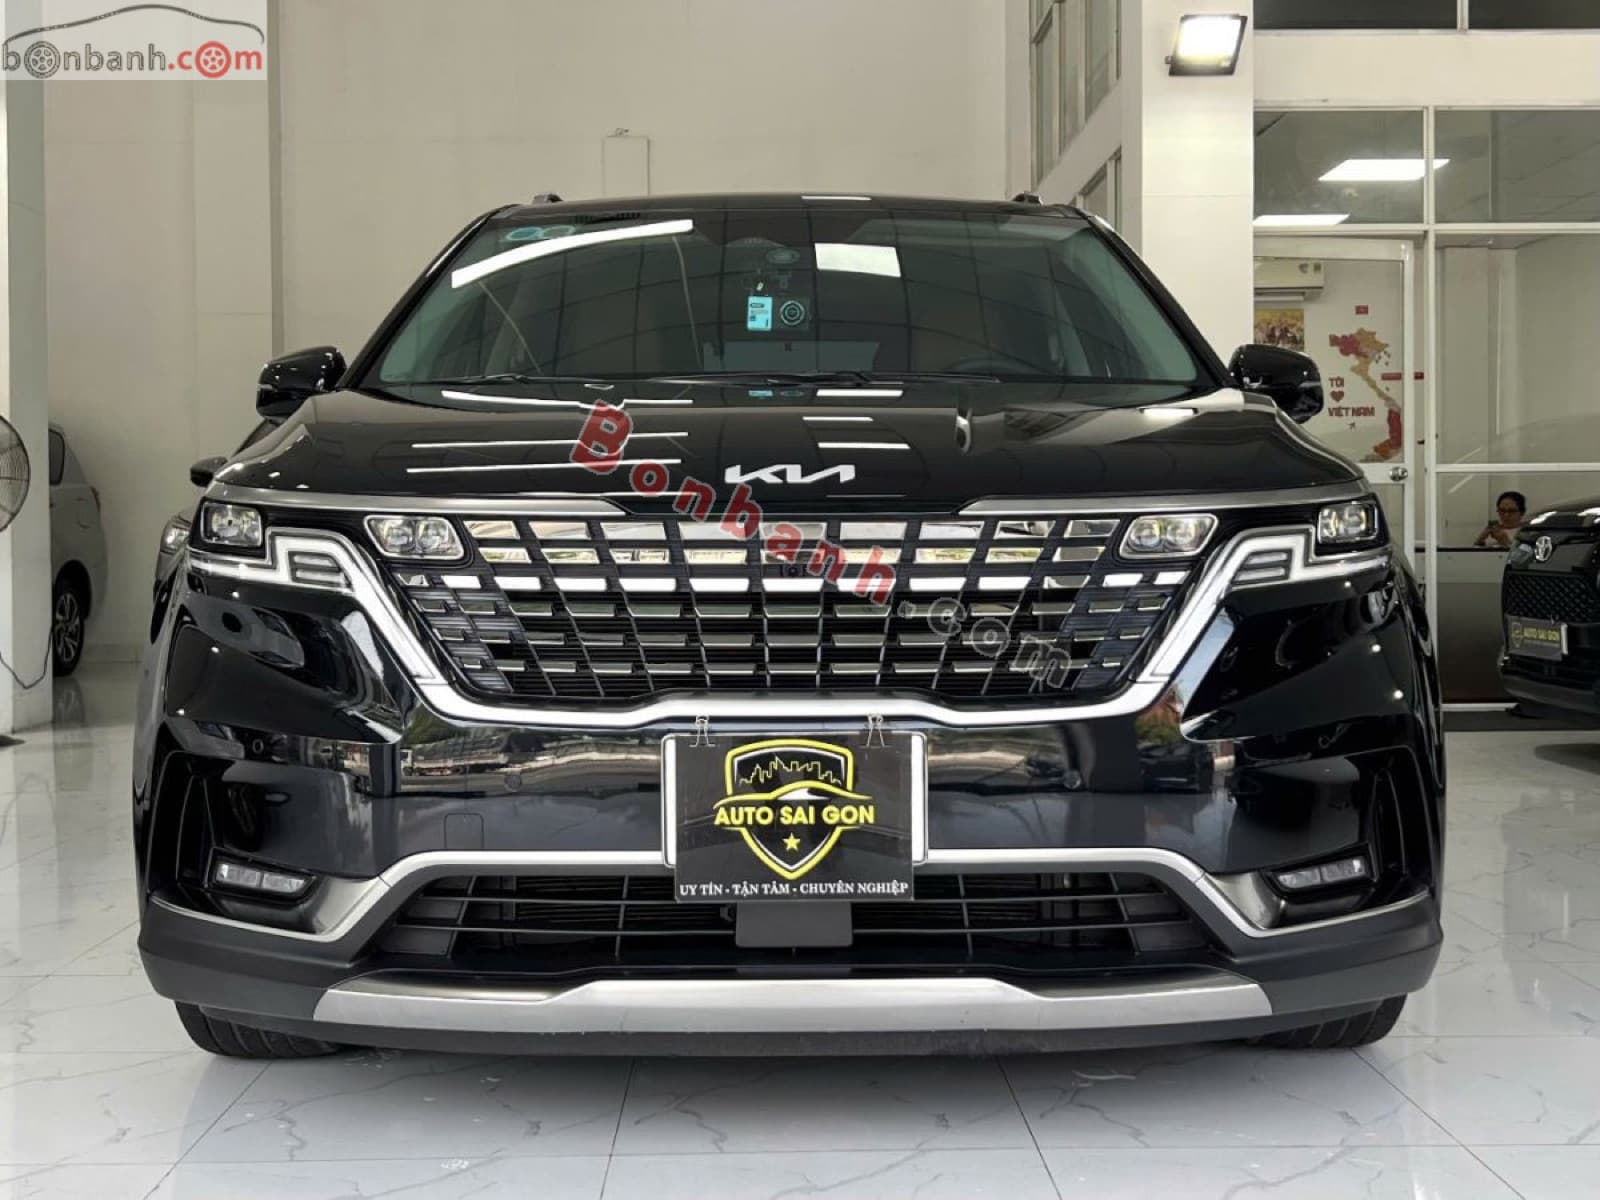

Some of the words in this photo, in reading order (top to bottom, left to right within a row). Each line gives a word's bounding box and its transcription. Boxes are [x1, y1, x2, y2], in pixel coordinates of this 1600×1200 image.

[1328, 376, 1344, 387] TÔI
[1351, 406, 1375, 417] NAM
[713, 805, 774, 825] AUTO
[779, 806, 815, 825] SAI
[821, 805, 875, 824] GON
[680, 884, 697, 896] UY
[701, 881, 723, 895] TÍN
[732, 881, 759, 896] TẬN
[763, 881, 790, 894] TÂM
[800, 880, 854, 894] CHUYÊN
[857, 879, 909, 895] NGHIỆP
